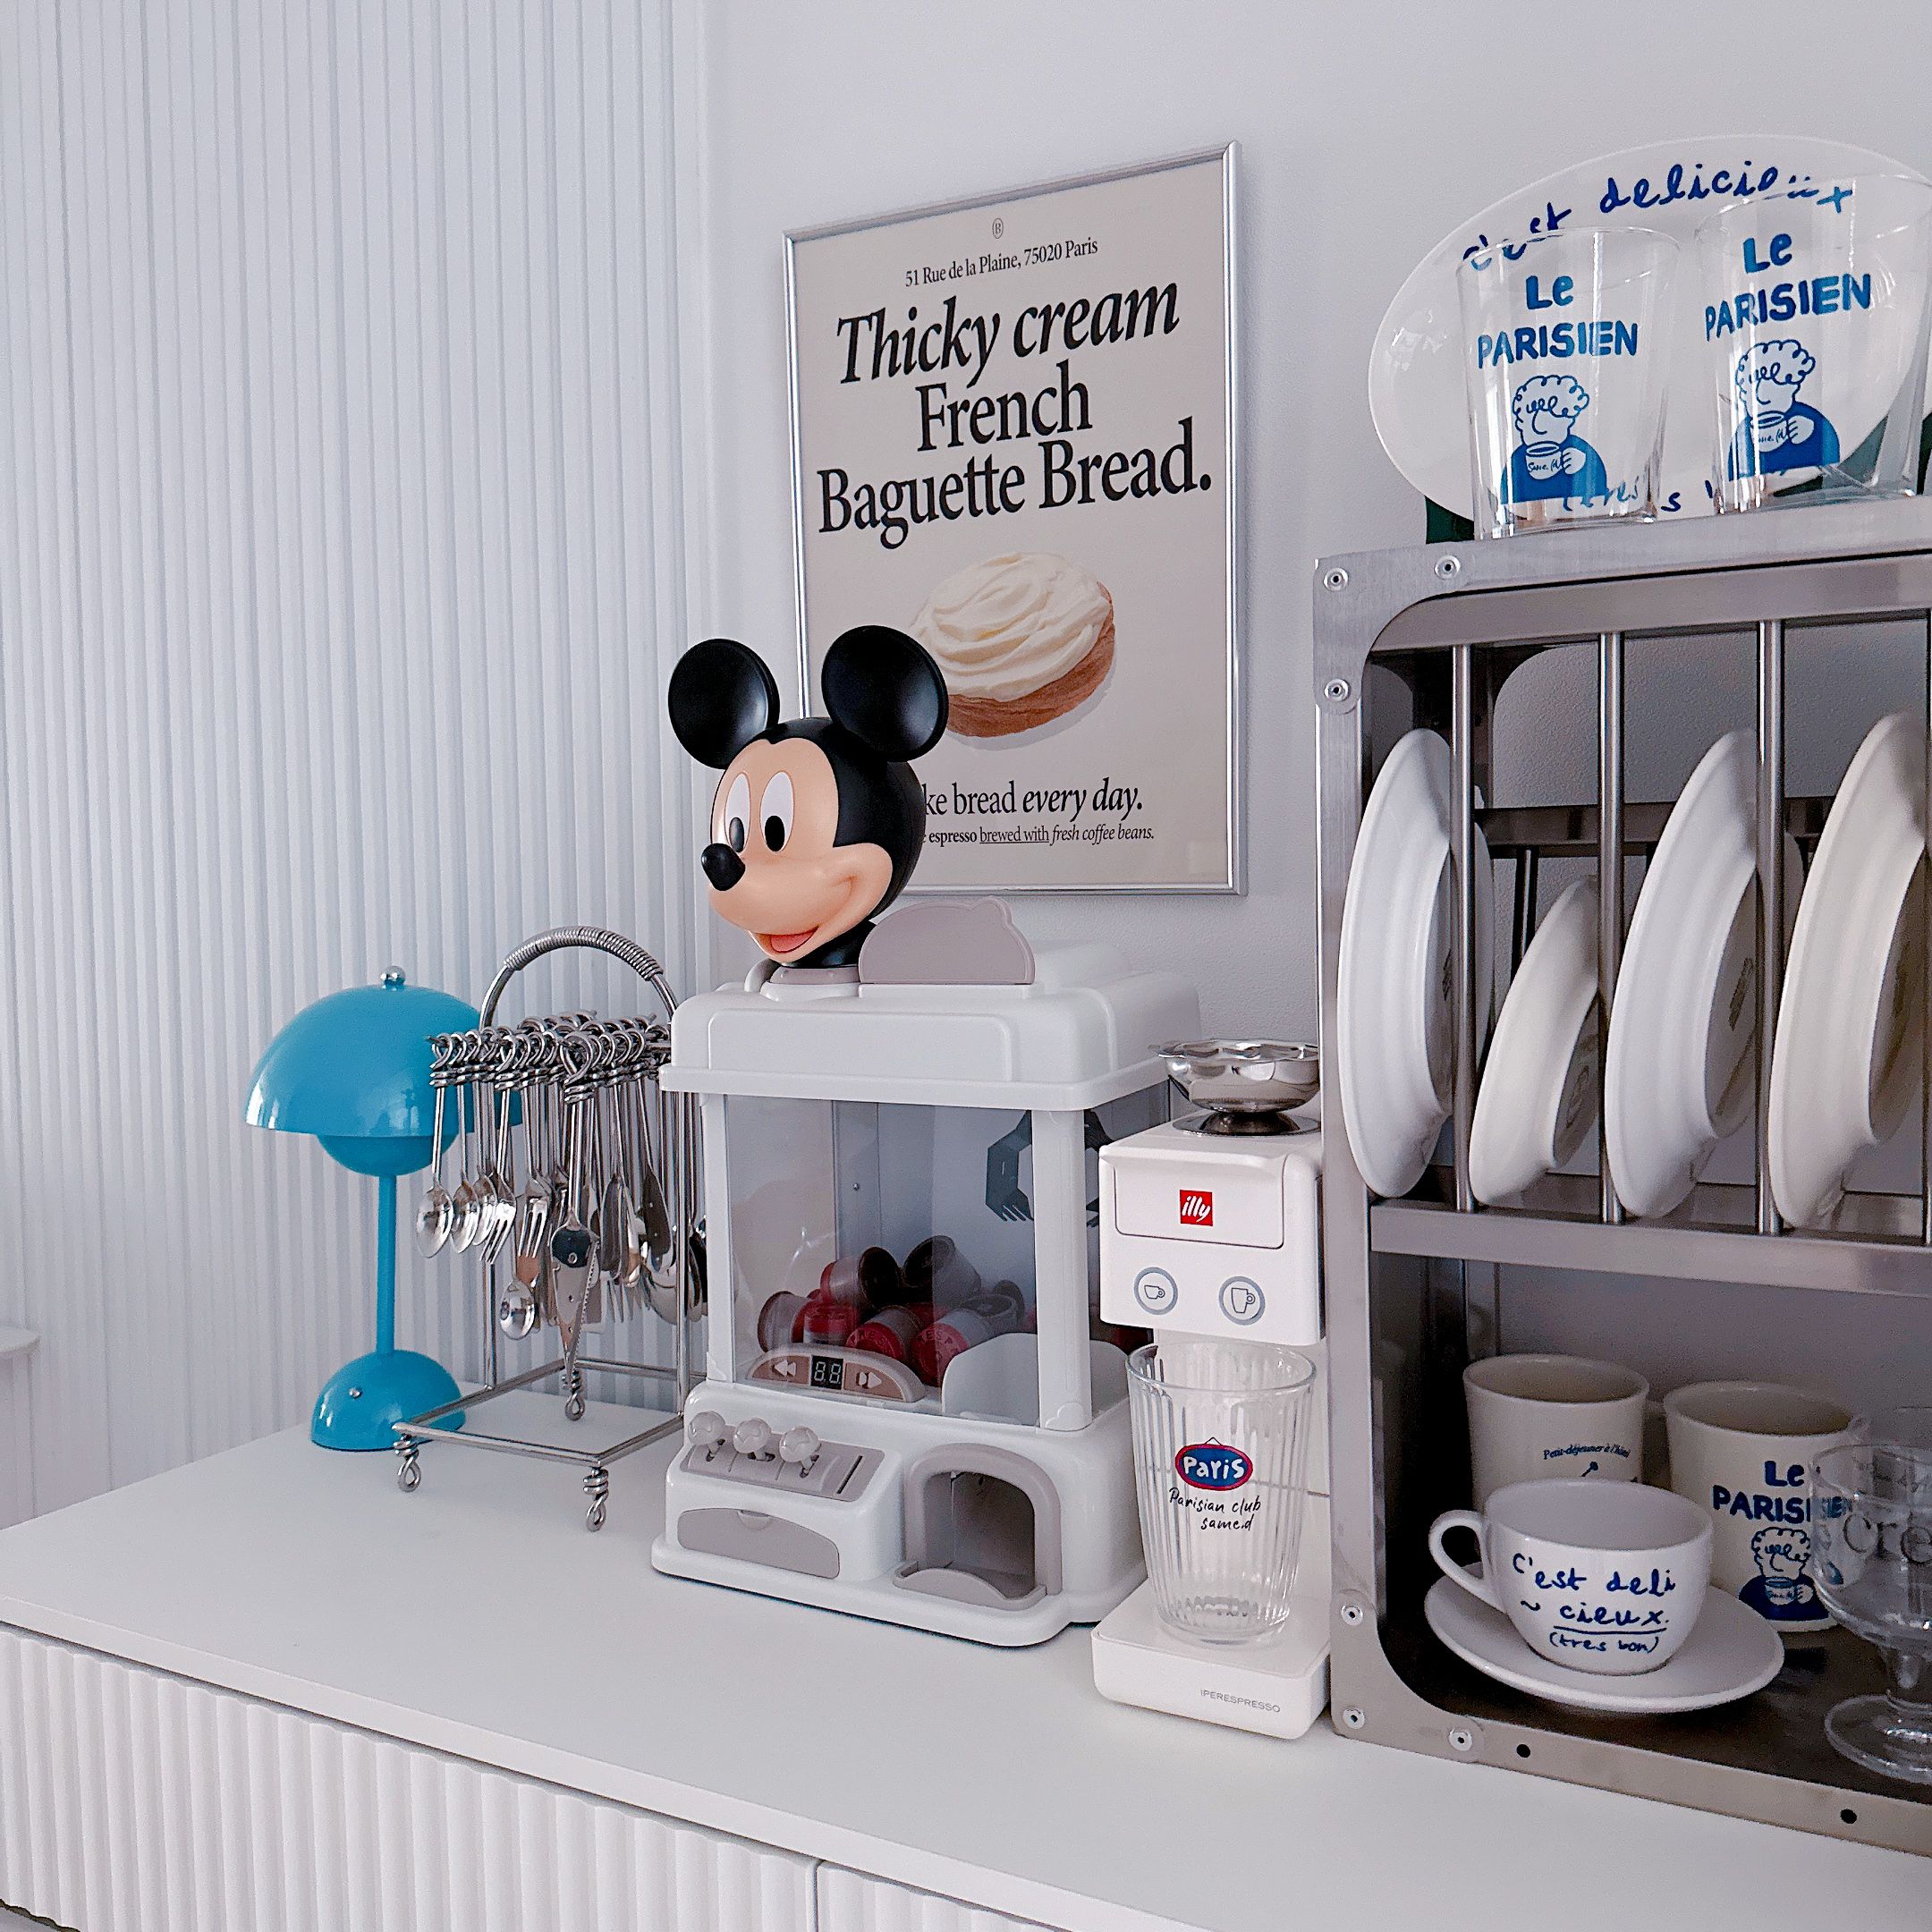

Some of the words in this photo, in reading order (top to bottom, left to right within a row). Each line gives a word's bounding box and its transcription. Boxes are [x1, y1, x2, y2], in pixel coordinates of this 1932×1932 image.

[905, 270, 919, 287] 51
[923, 267, 946, 284] Rue
[948, 260, 963, 280] de
[966, 258, 977, 276] la
[979, 253, 1021, 274] Plaine,
[1024, 242, 1063, 267] 75020
[1065, 236, 1098, 258] Paris
[1742, 233, 1792, 273] Le
[1526, 275, 1575, 309] Le
[1705, 274, 1870, 342] PARISIEN
[836, 295, 1000, 388] Thicky
[1013, 283, 1180, 358] cream
[1478, 320, 1638, 369] PARISIEN
[915, 359, 1093, 452] French
[817, 454, 1025, 550] Baguette
[1038, 416, 1212, 509] Bread.
[952, 780, 1018, 815] bread
[1022, 788, 1087, 822] every
[1092, 776, 1143, 821] day.
[928, 830, 978, 847] espresso
[979, 825, 1021, 842] brewed
[1024, 825, 1049, 842] with
[1049, 824, 1080, 846] fresh
[1082, 823, 1115, 845] coffee
[1117, 822, 1155, 841] beans.
[1182, 1195, 1211, 1223] illy
[1764, 1460, 1805, 1487] Le
[1168, 1487, 1224, 1513] Parisian
[1232, 1496, 1261, 1515] club
[1513, 1553, 1587, 1590] C'est
[1606, 1568, 1676, 1597] deli
[1200, 1689, 1281, 1713] IPERESPRESSO
